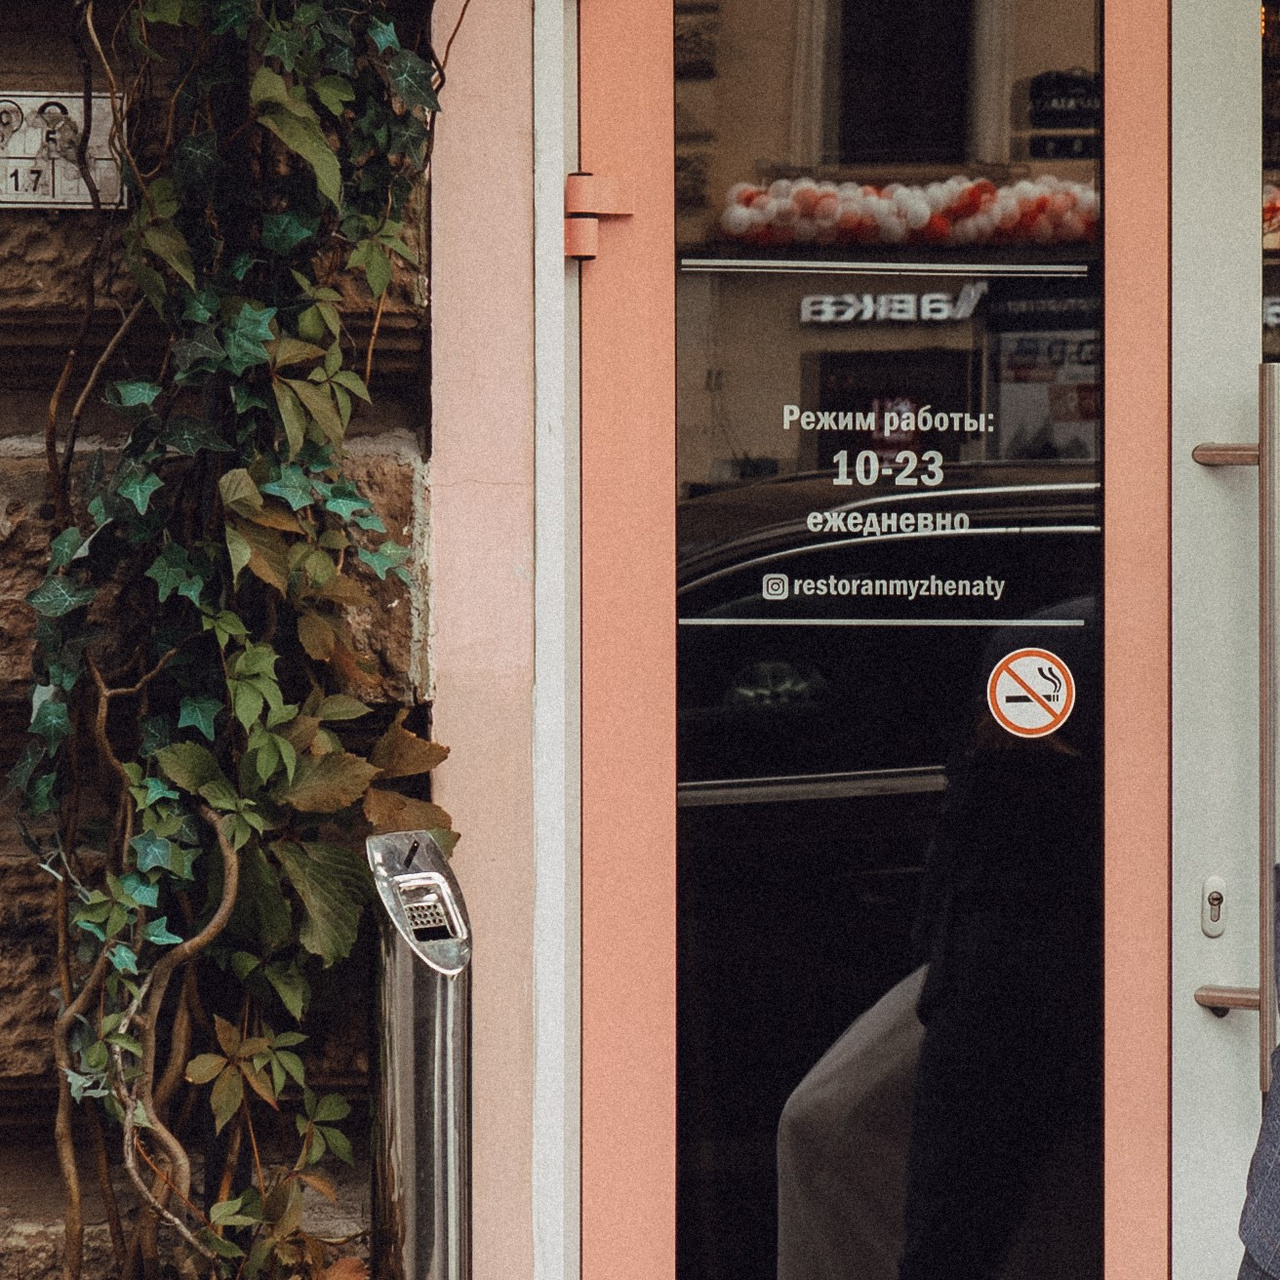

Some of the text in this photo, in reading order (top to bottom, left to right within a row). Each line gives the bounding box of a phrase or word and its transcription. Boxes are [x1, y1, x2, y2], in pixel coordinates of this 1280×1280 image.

[783, 405, 994, 436] Режим работы:
[832, 450, 944, 486] 10-23
[806, 511, 970, 536] ежедневно
[794, 575, 1005, 601] restoranmyzhenaty
